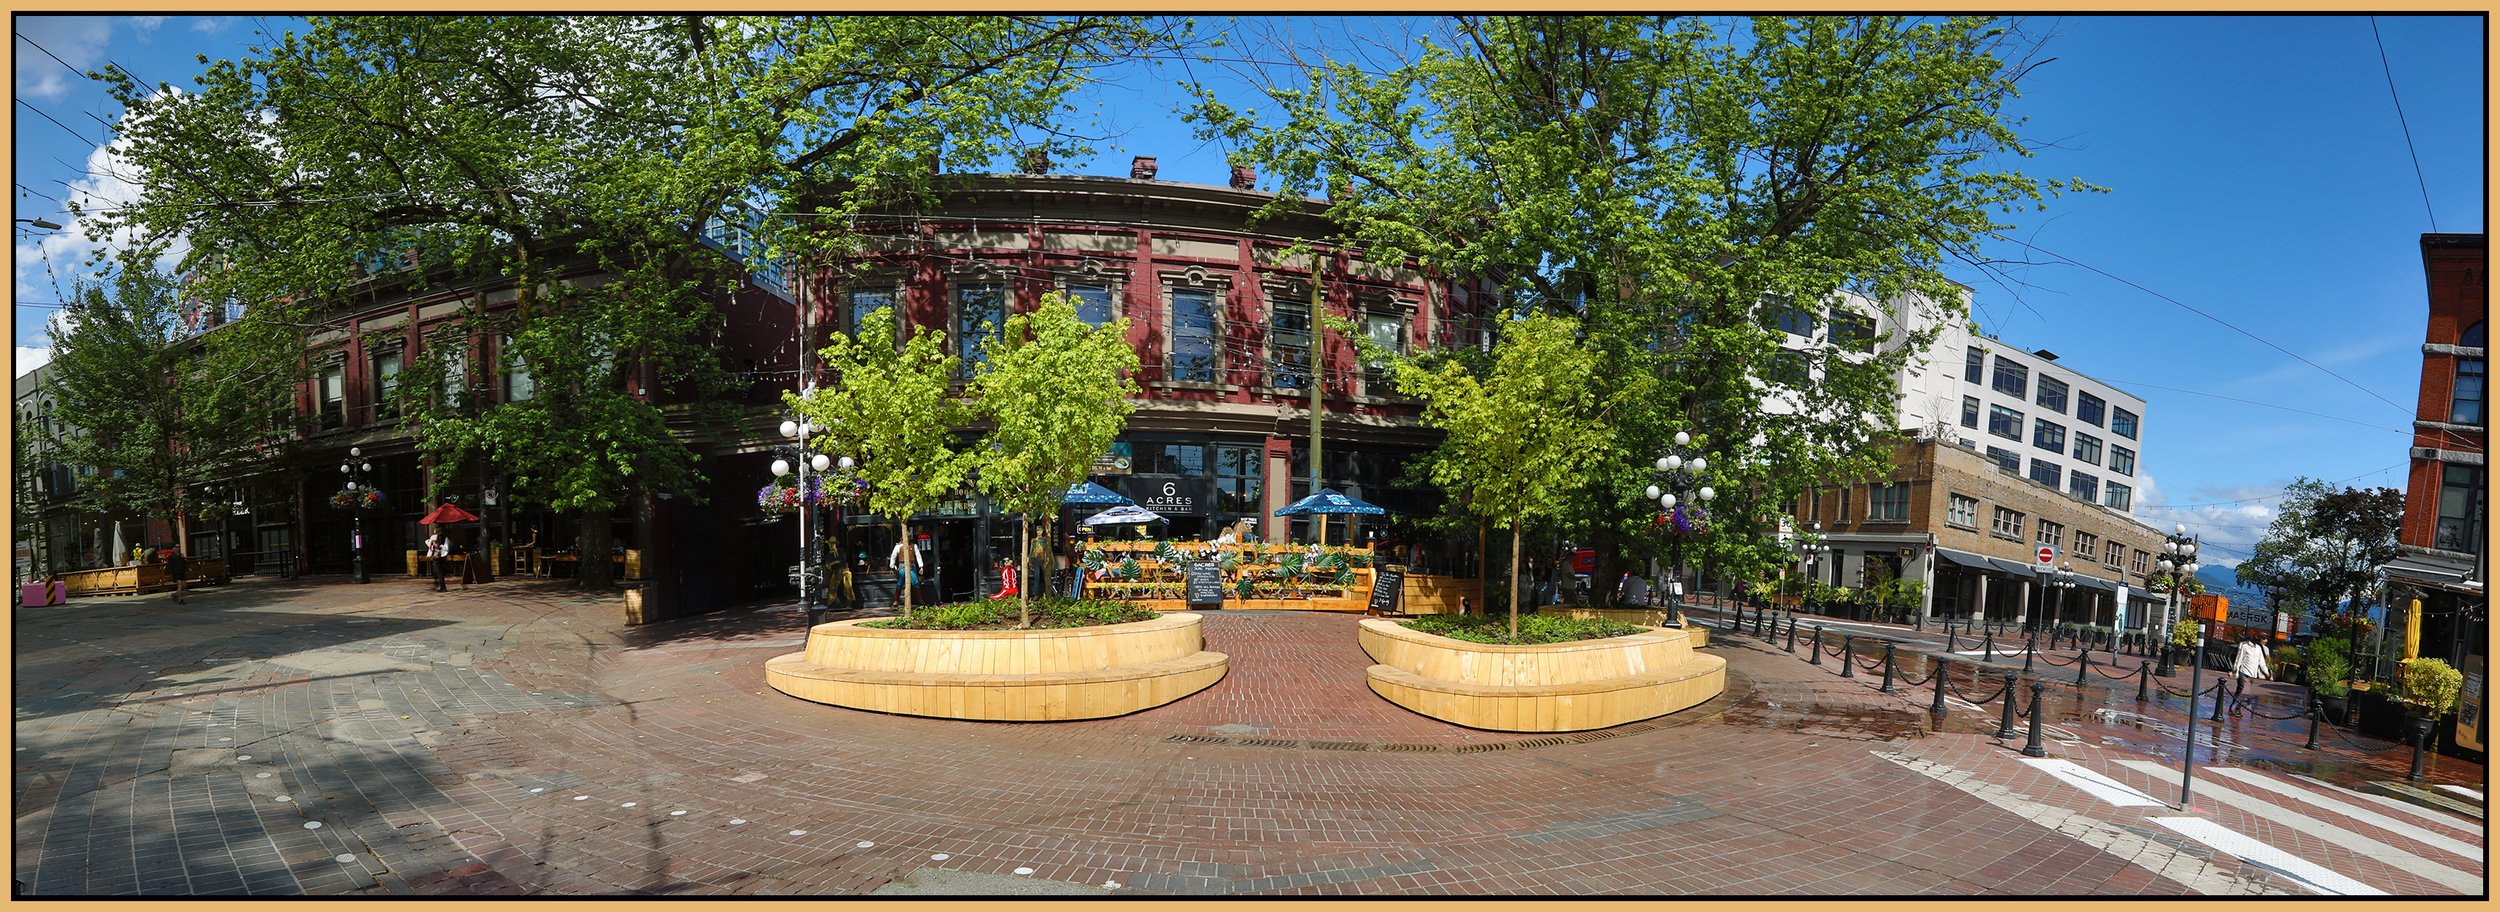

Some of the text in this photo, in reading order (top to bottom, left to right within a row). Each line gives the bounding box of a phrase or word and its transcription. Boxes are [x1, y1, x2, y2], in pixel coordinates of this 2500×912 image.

[1163, 482, 1176, 496] 6
[1146, 496, 1192, 504] ACRES
[2227, 610, 2268, 624] MAERSK
